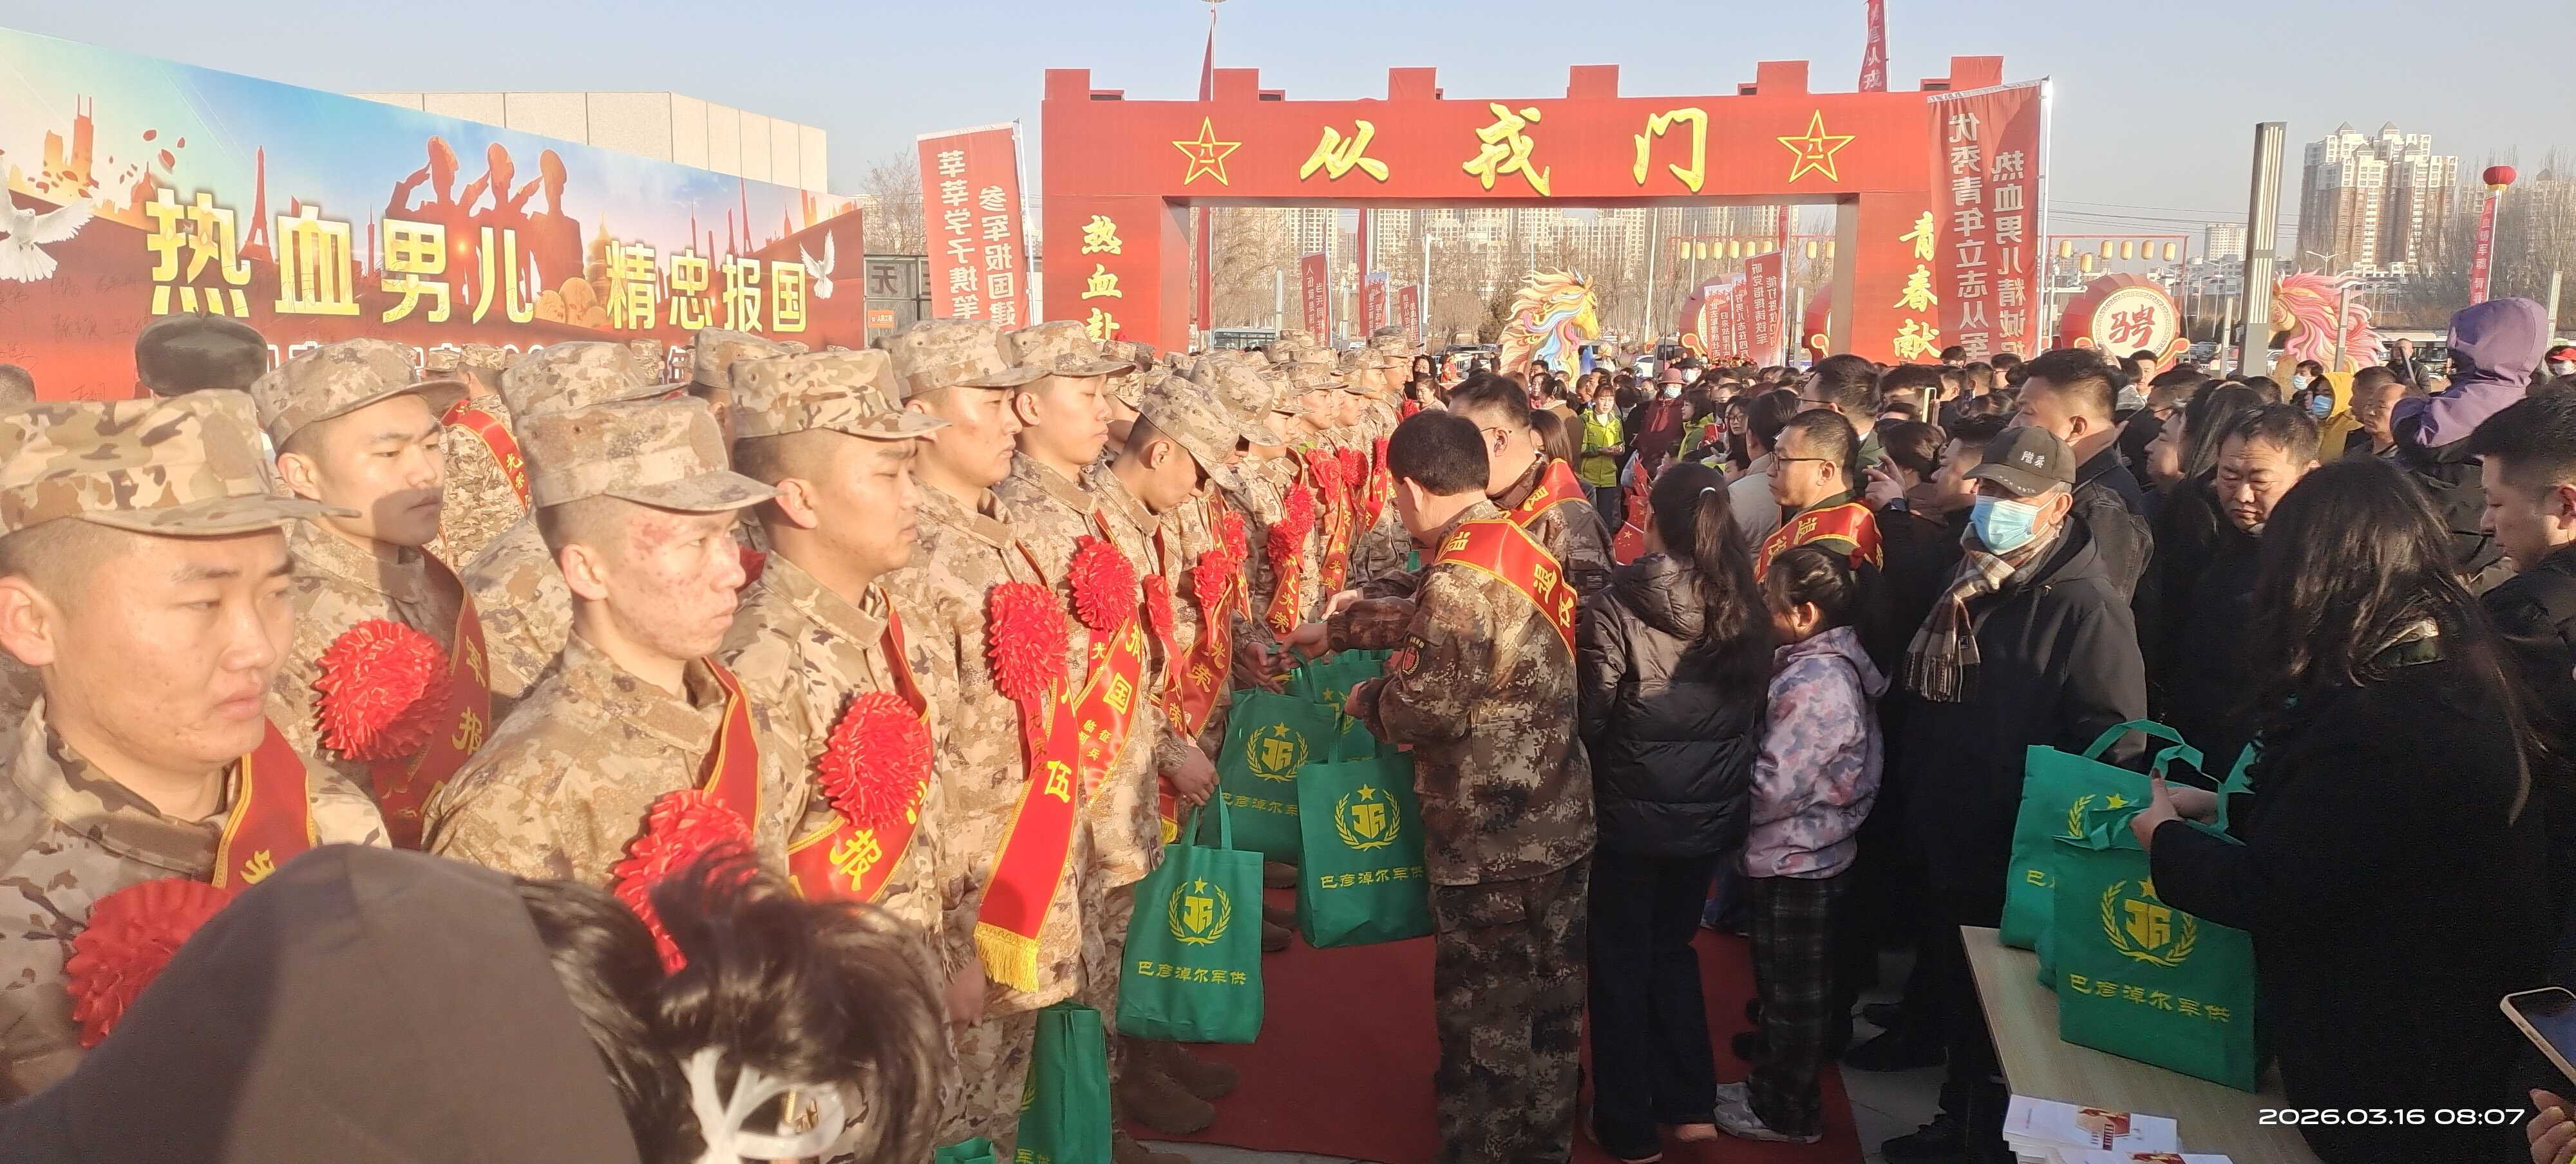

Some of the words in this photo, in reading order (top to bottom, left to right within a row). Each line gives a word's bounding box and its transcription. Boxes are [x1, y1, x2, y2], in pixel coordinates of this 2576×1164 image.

[1199, 144, 1215, 164] 八一
[1300, 102, 1708, 197] 从戎门
[1806, 138, 1824, 159] 八一
[146, 188, 535, 324] 热血男儿
[604, 238, 808, 333] 精忠报国
[1893, 211, 1942, 361] 青春献
[2108, 304, 2156, 349] 骋
[1320, 865, 1425, 890] 巴彦淖尔军供
[2025, 869, 2055, 889] 巴
[1138, 960, 1247, 986] 巴彦淖尔军供
[2069, 973, 2231, 1024] 巴彦淖尔军供
